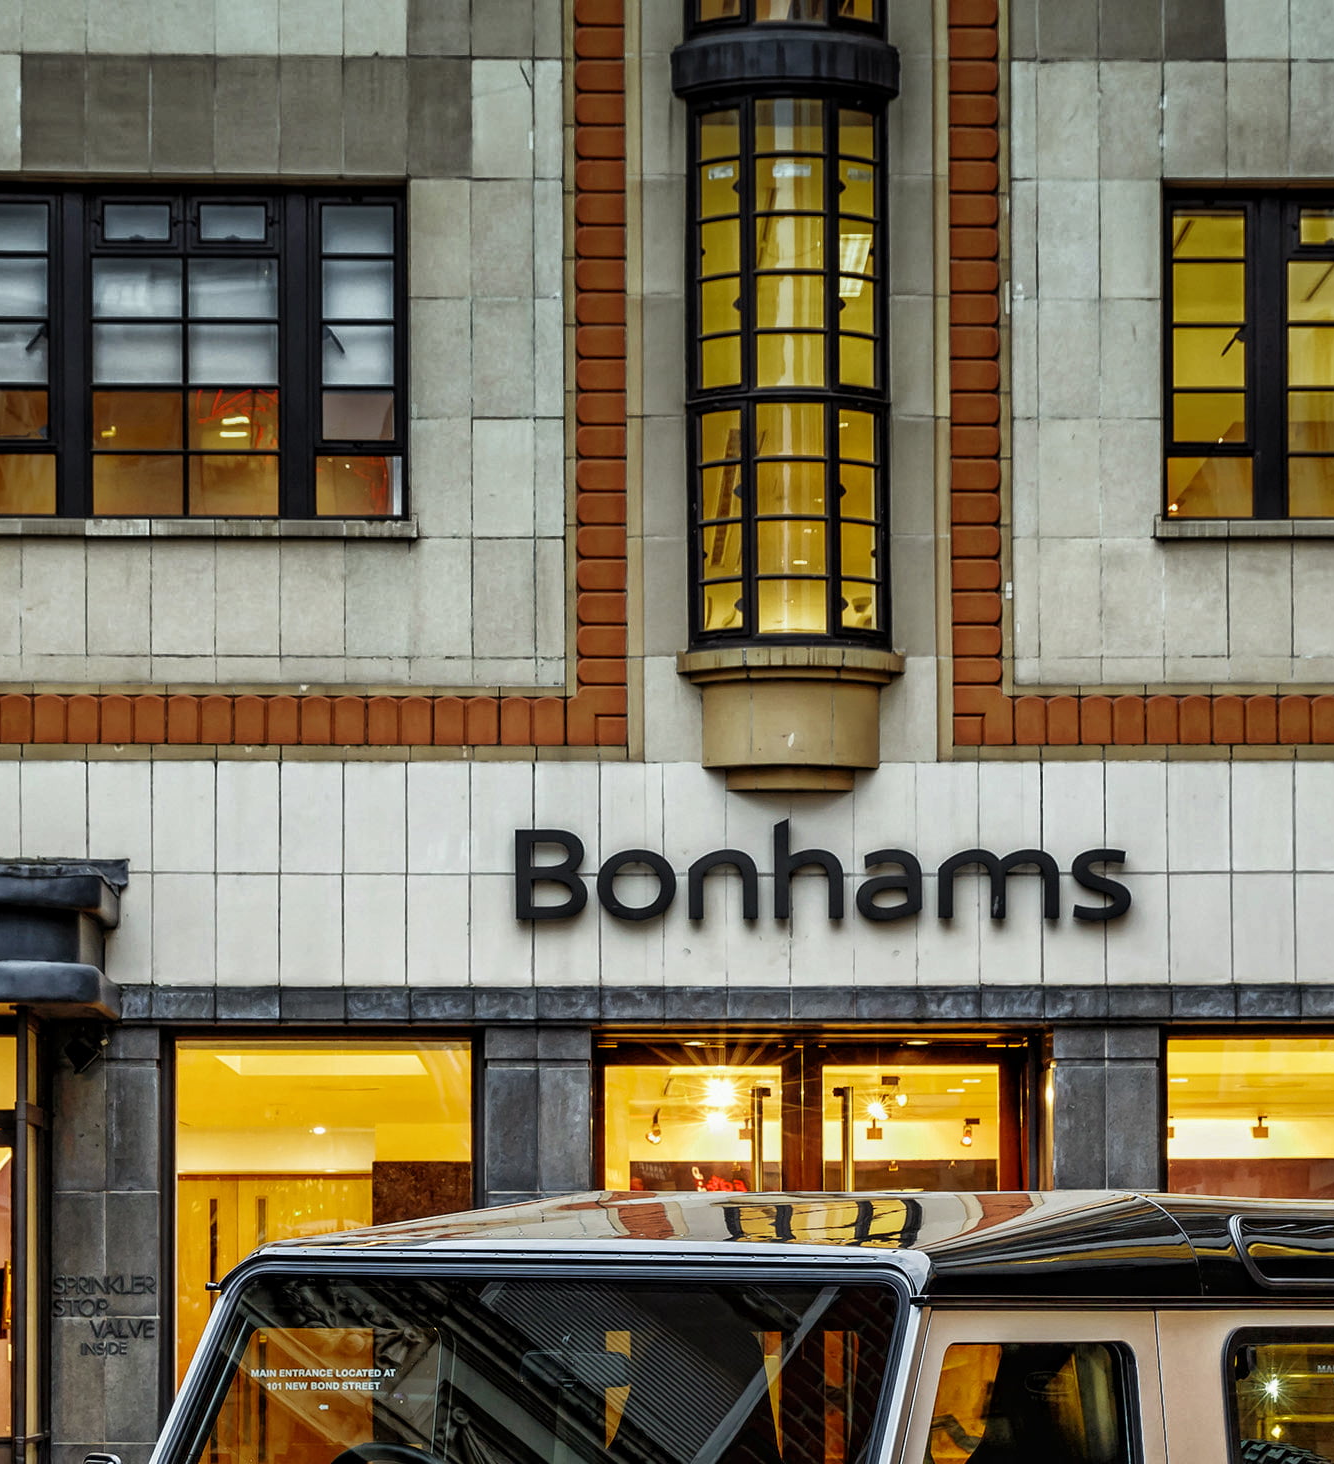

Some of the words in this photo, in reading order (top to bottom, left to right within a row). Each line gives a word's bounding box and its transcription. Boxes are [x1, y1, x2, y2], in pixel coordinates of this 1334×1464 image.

[514, 818, 1132, 921] Bonhams
[53, 1275, 157, 1296] SPRINKLER
[53, 1298, 109, 1318] STOP
[89, 1320, 156, 1339] VALVE
[80, 1341, 128, 1356] INSIDE
[250, 1368, 277, 1378] MAIN
[279, 1368, 334, 1378] ENTRANCE
[335, 1368, 382, 1378] LOCATED
[383, 1368, 397, 1378] AT
[267, 1381, 282, 1391] 101
[285, 1381, 308, 1391] NEW
[310, 1381, 340, 1391] BOND
[342, 1381, 381, 1391] STREET
